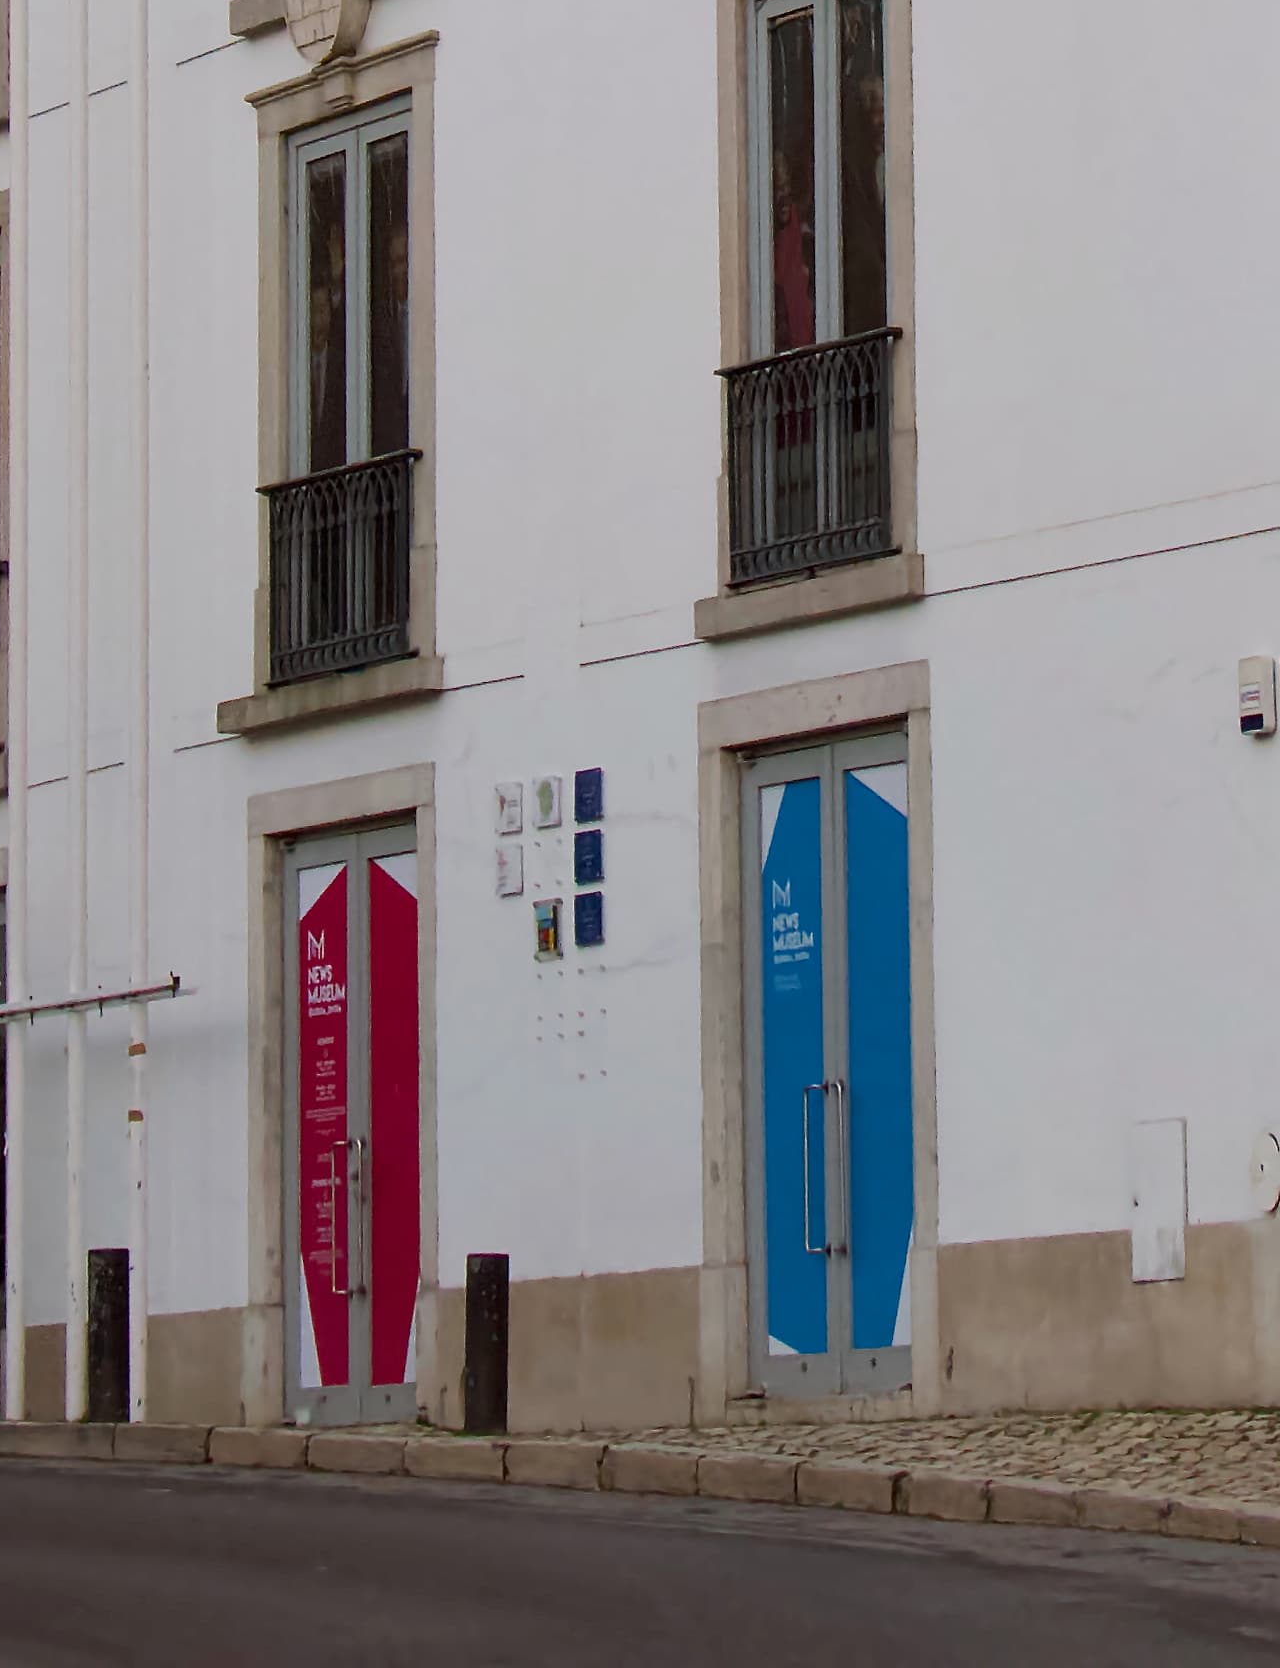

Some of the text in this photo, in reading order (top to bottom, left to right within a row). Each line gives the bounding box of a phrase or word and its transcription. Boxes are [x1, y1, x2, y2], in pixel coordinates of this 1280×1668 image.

[773, 912, 800, 933] NEWS
[773, 931, 814, 951] MUSEUM
[308, 965, 333, 985] NEWS
[308, 984, 346, 1004] MUSEUM
